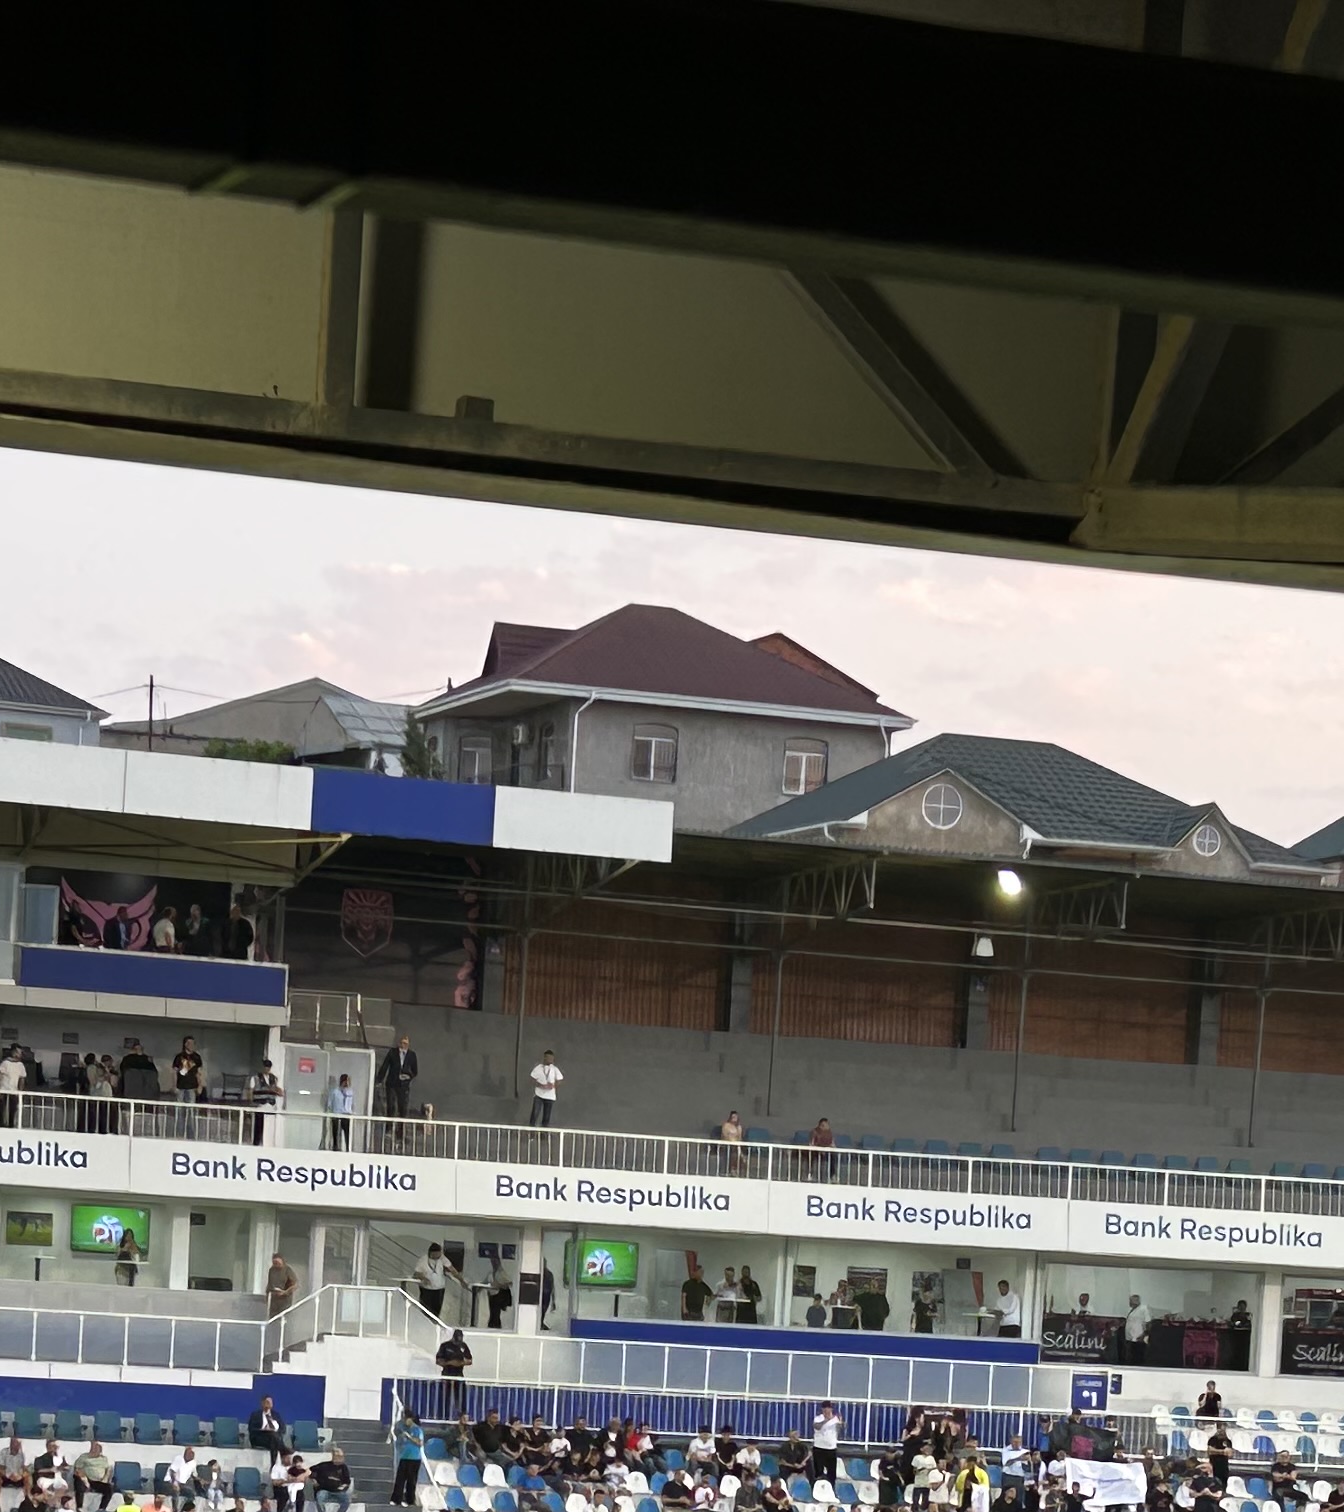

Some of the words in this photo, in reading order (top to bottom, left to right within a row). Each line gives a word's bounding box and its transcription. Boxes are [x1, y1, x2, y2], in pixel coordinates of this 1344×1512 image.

[171, 1152, 247, 1181] Bank
[256, 1158, 416, 1192] Respublika
[495, 1174, 568, 1202] Bank
[577, 1179, 730, 1212] Respublika
[806, 1194, 875, 1222] Bank
[884, 1200, 1032, 1231] Respublika
[1105, 1213, 1171, 1239] Bank
[1180, 1218, 1323, 1248] Respublika
